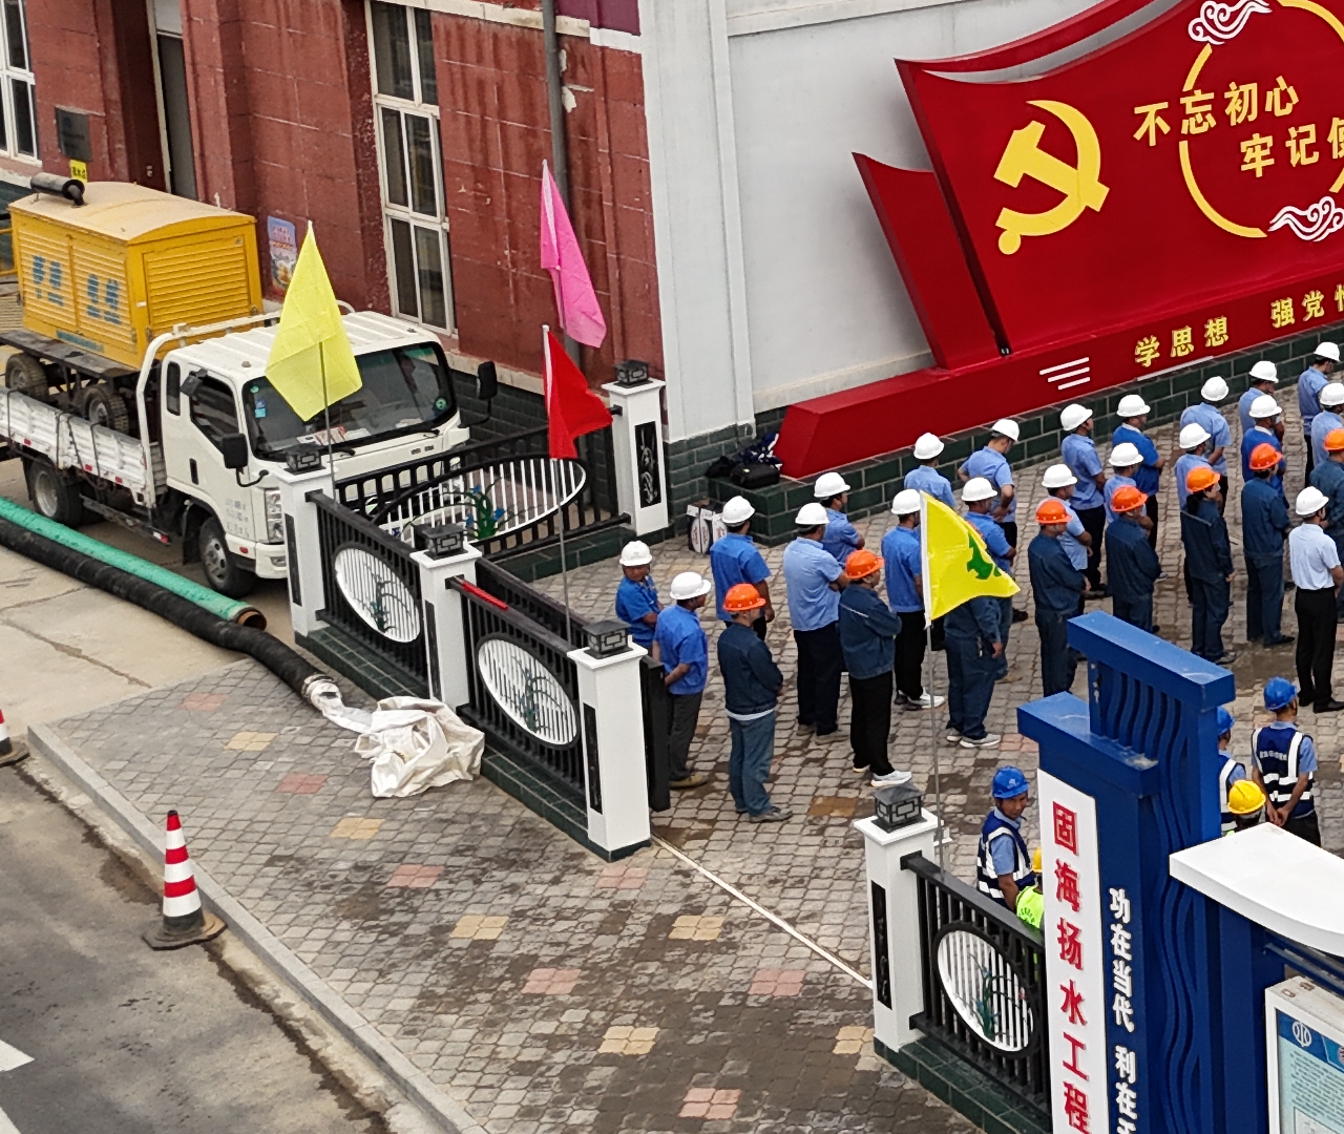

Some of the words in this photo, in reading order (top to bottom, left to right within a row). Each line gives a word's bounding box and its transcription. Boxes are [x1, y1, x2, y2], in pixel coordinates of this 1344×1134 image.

[1133, 75, 1299, 147] 不忘初心
[1134, 316, 1229, 368] 学思想
[1053, 801, 1091, 1134] 固海扬水工程
[1109, 887, 1135, 1033] 功在当代
